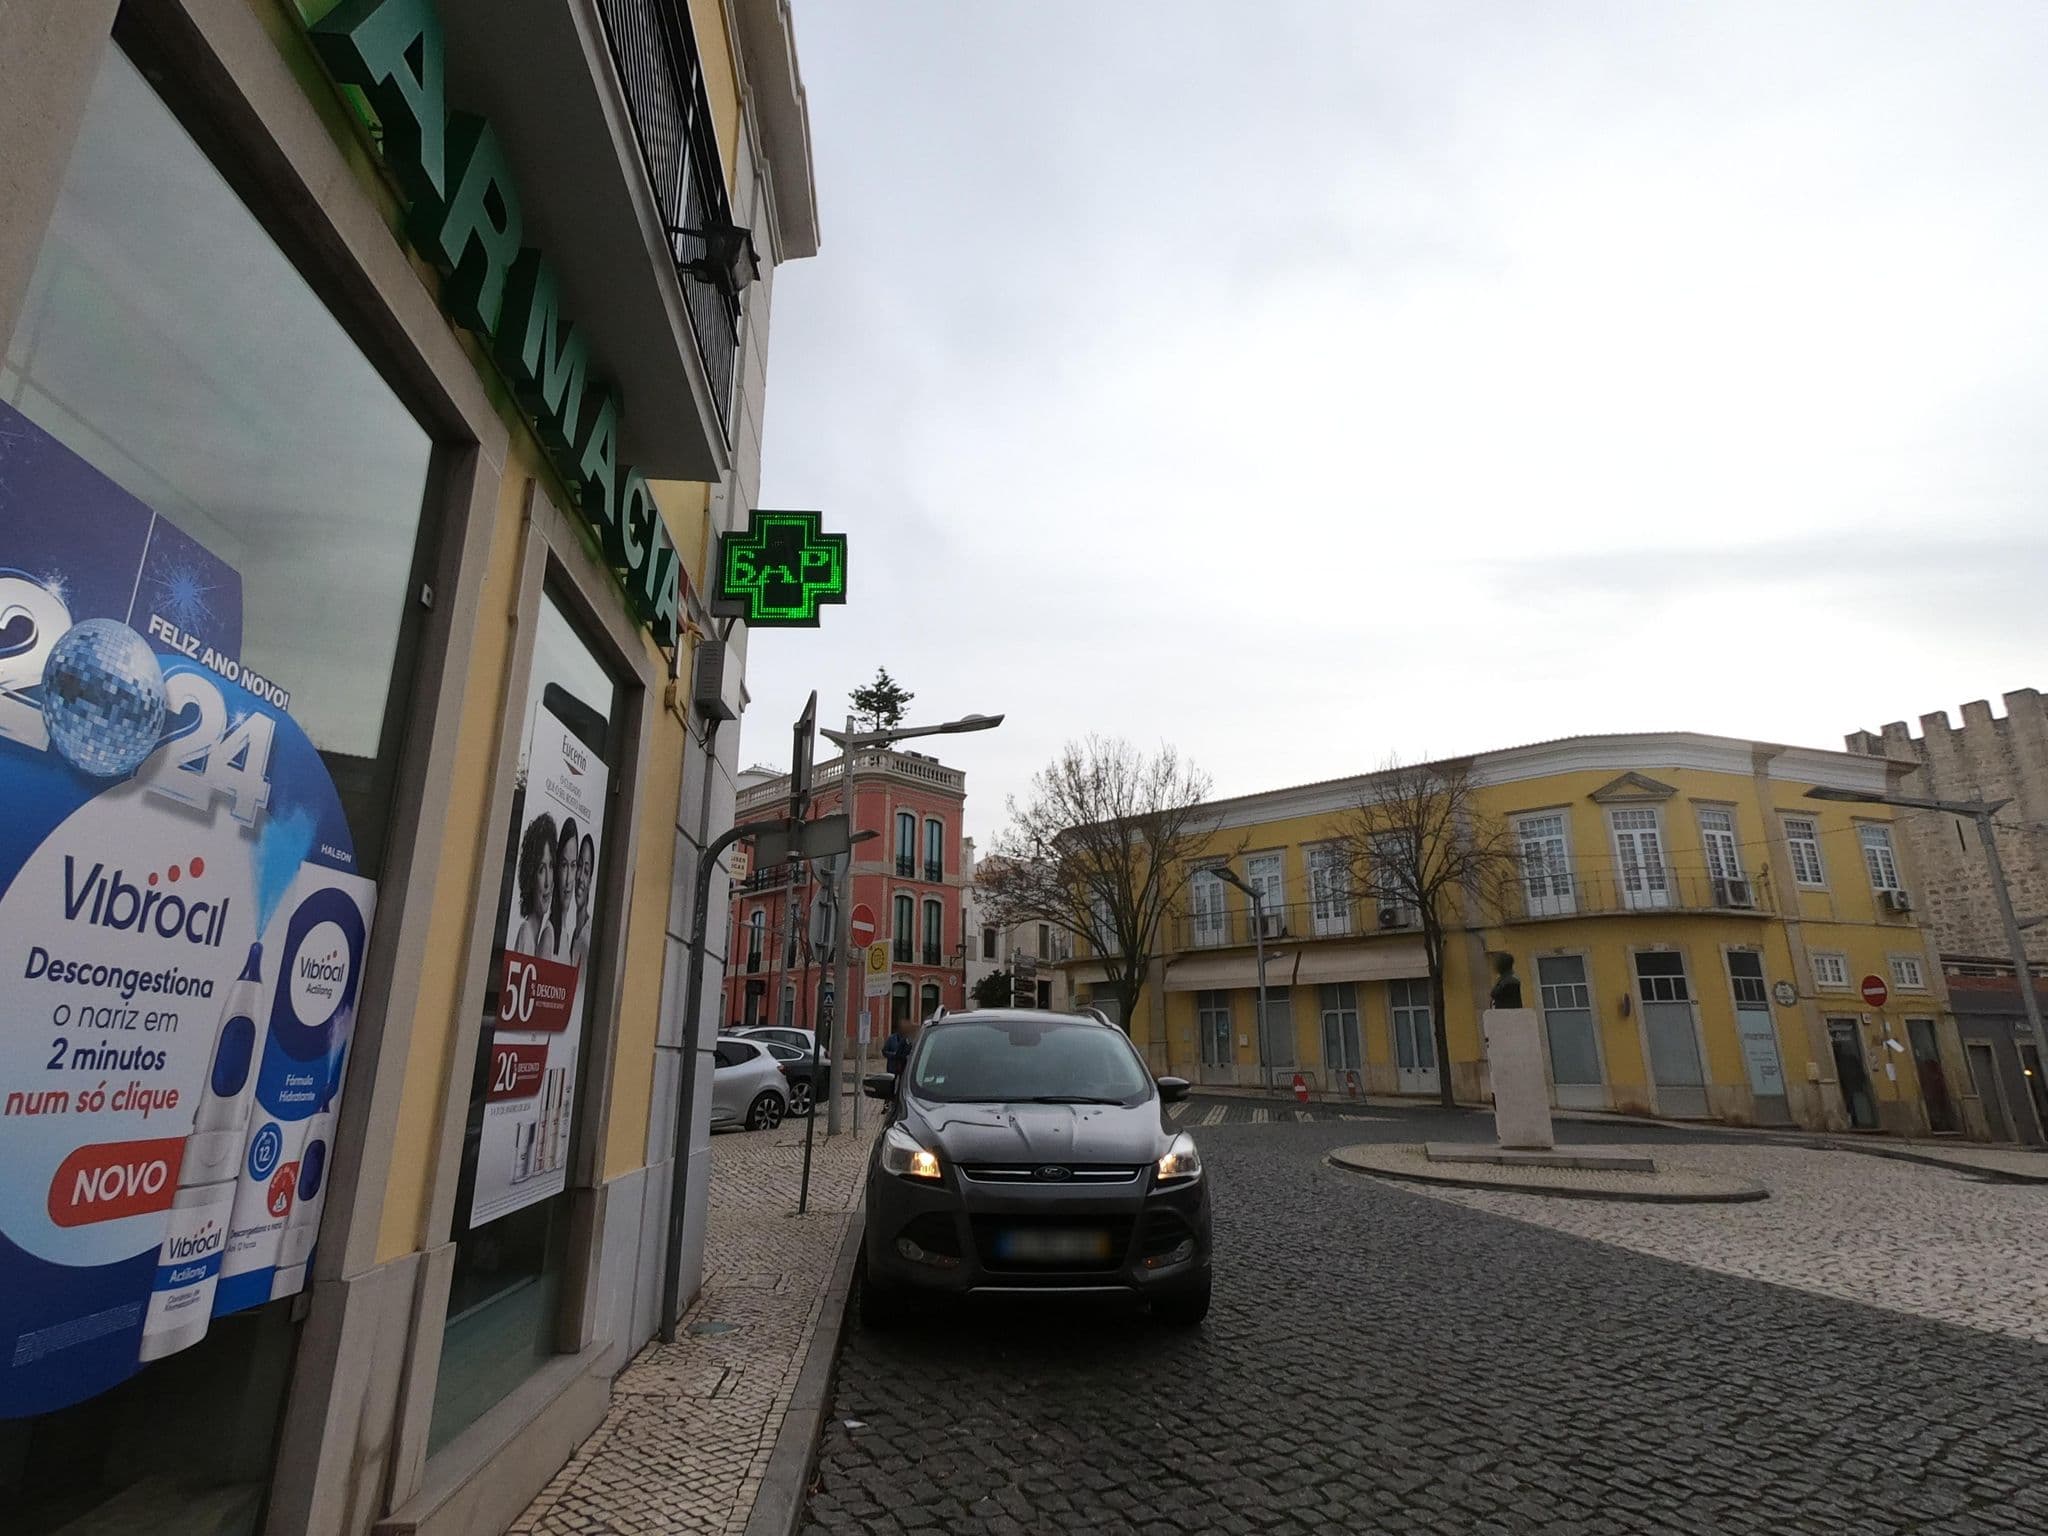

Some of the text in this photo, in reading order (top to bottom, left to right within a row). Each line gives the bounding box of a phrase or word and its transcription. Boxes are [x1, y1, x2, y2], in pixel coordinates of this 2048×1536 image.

[149, 613, 291, 712] FELIZ ANO NOVO!
[562, 734, 587, 772] Eucerin
[321, 843, 352, 864] HALEON
[65, 855, 230, 947] Vibrocil
[24, 946, 214, 1000] Descongestiona
[301, 953, 344, 983] Vibrocil
[536, 983, 566, 1001] DESCONTO
[53, 1001, 179, 1033] o nariz em
[47, 1037, 166, 1071] 2 minutos
[4, 1080, 180, 1119] num só clique
[259, 1146, 271, 1161] 12
[71, 1159, 168, 1207] NOVO
[169, 1223, 222, 1259] Vibrocil
